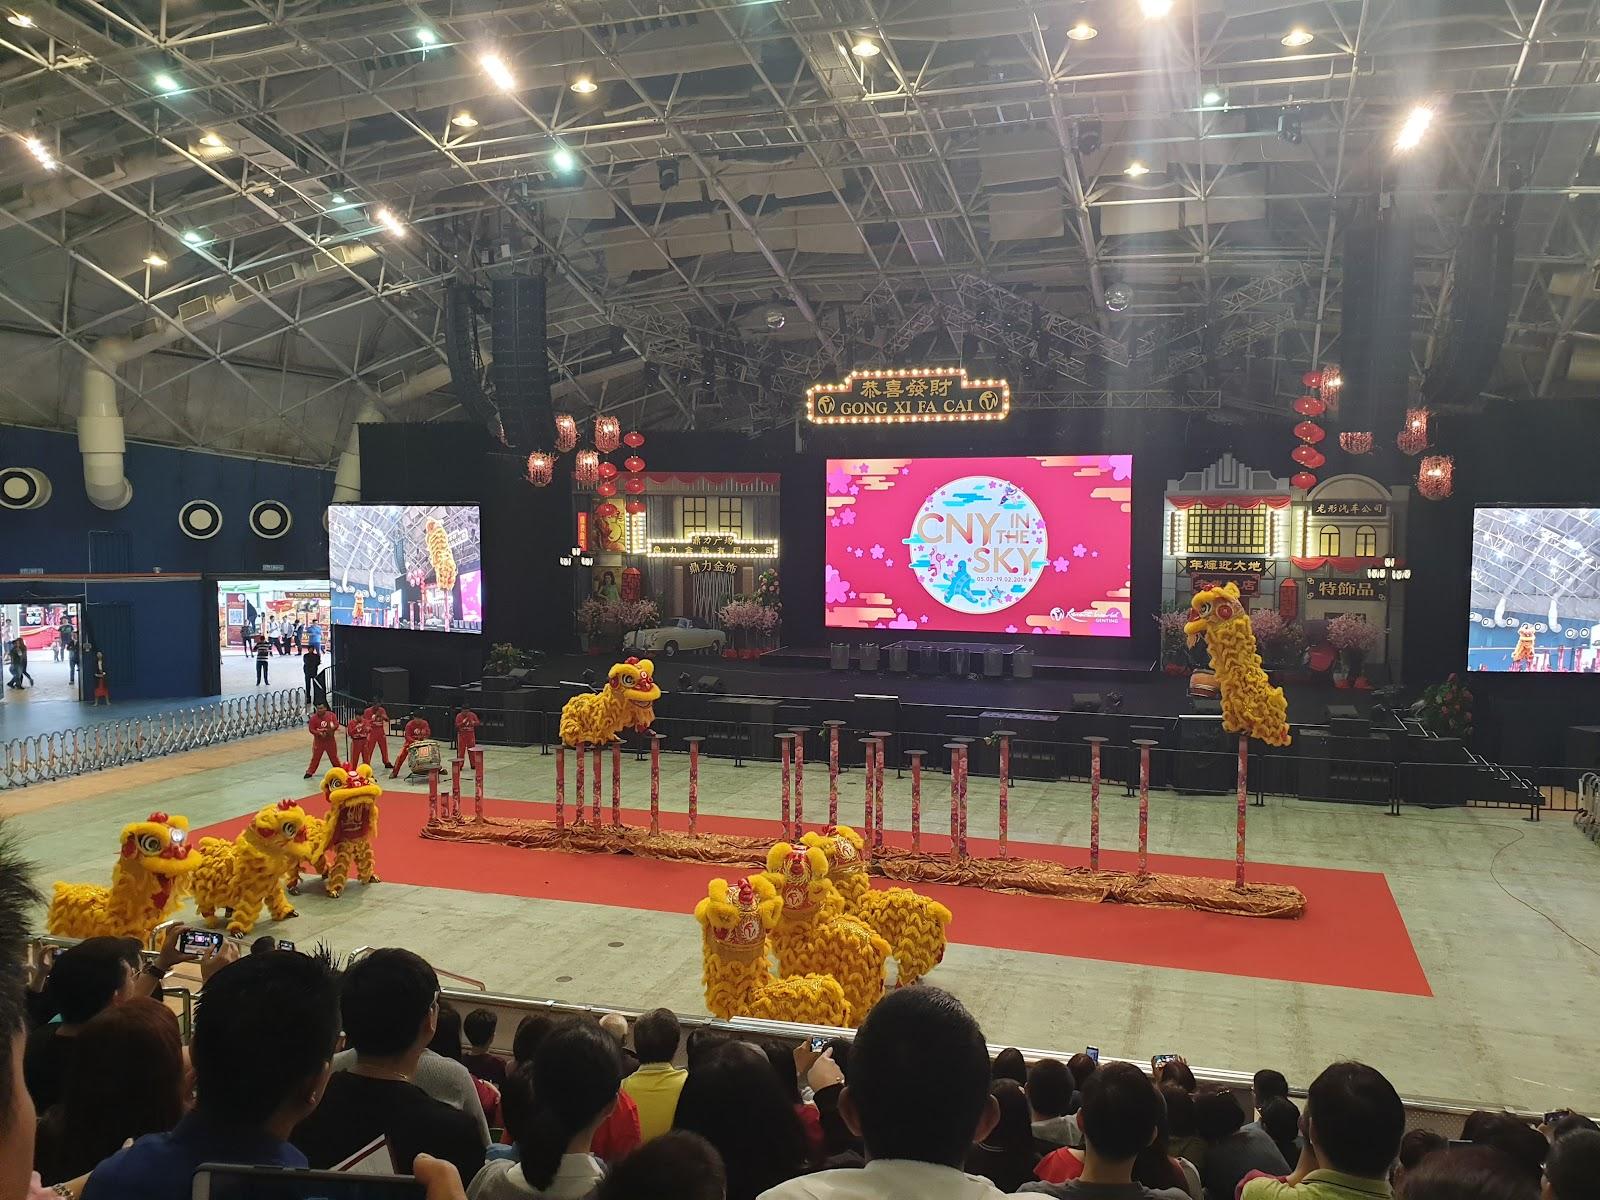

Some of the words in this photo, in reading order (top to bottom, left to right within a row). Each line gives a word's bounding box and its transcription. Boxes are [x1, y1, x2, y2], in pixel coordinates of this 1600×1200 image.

[860, 379, 953, 398] 恭喜發財
[840, 402, 888, 415] GONG
[894, 401, 912, 413] XI
[917, 400, 937, 413] FA
[943, 399, 973, 412] CAI
[917, 513, 1001, 546] CNY
[1010, 513, 1030, 529] IN
[996, 530, 1030, 544] THE
[973, 547, 1039, 576] SKY
